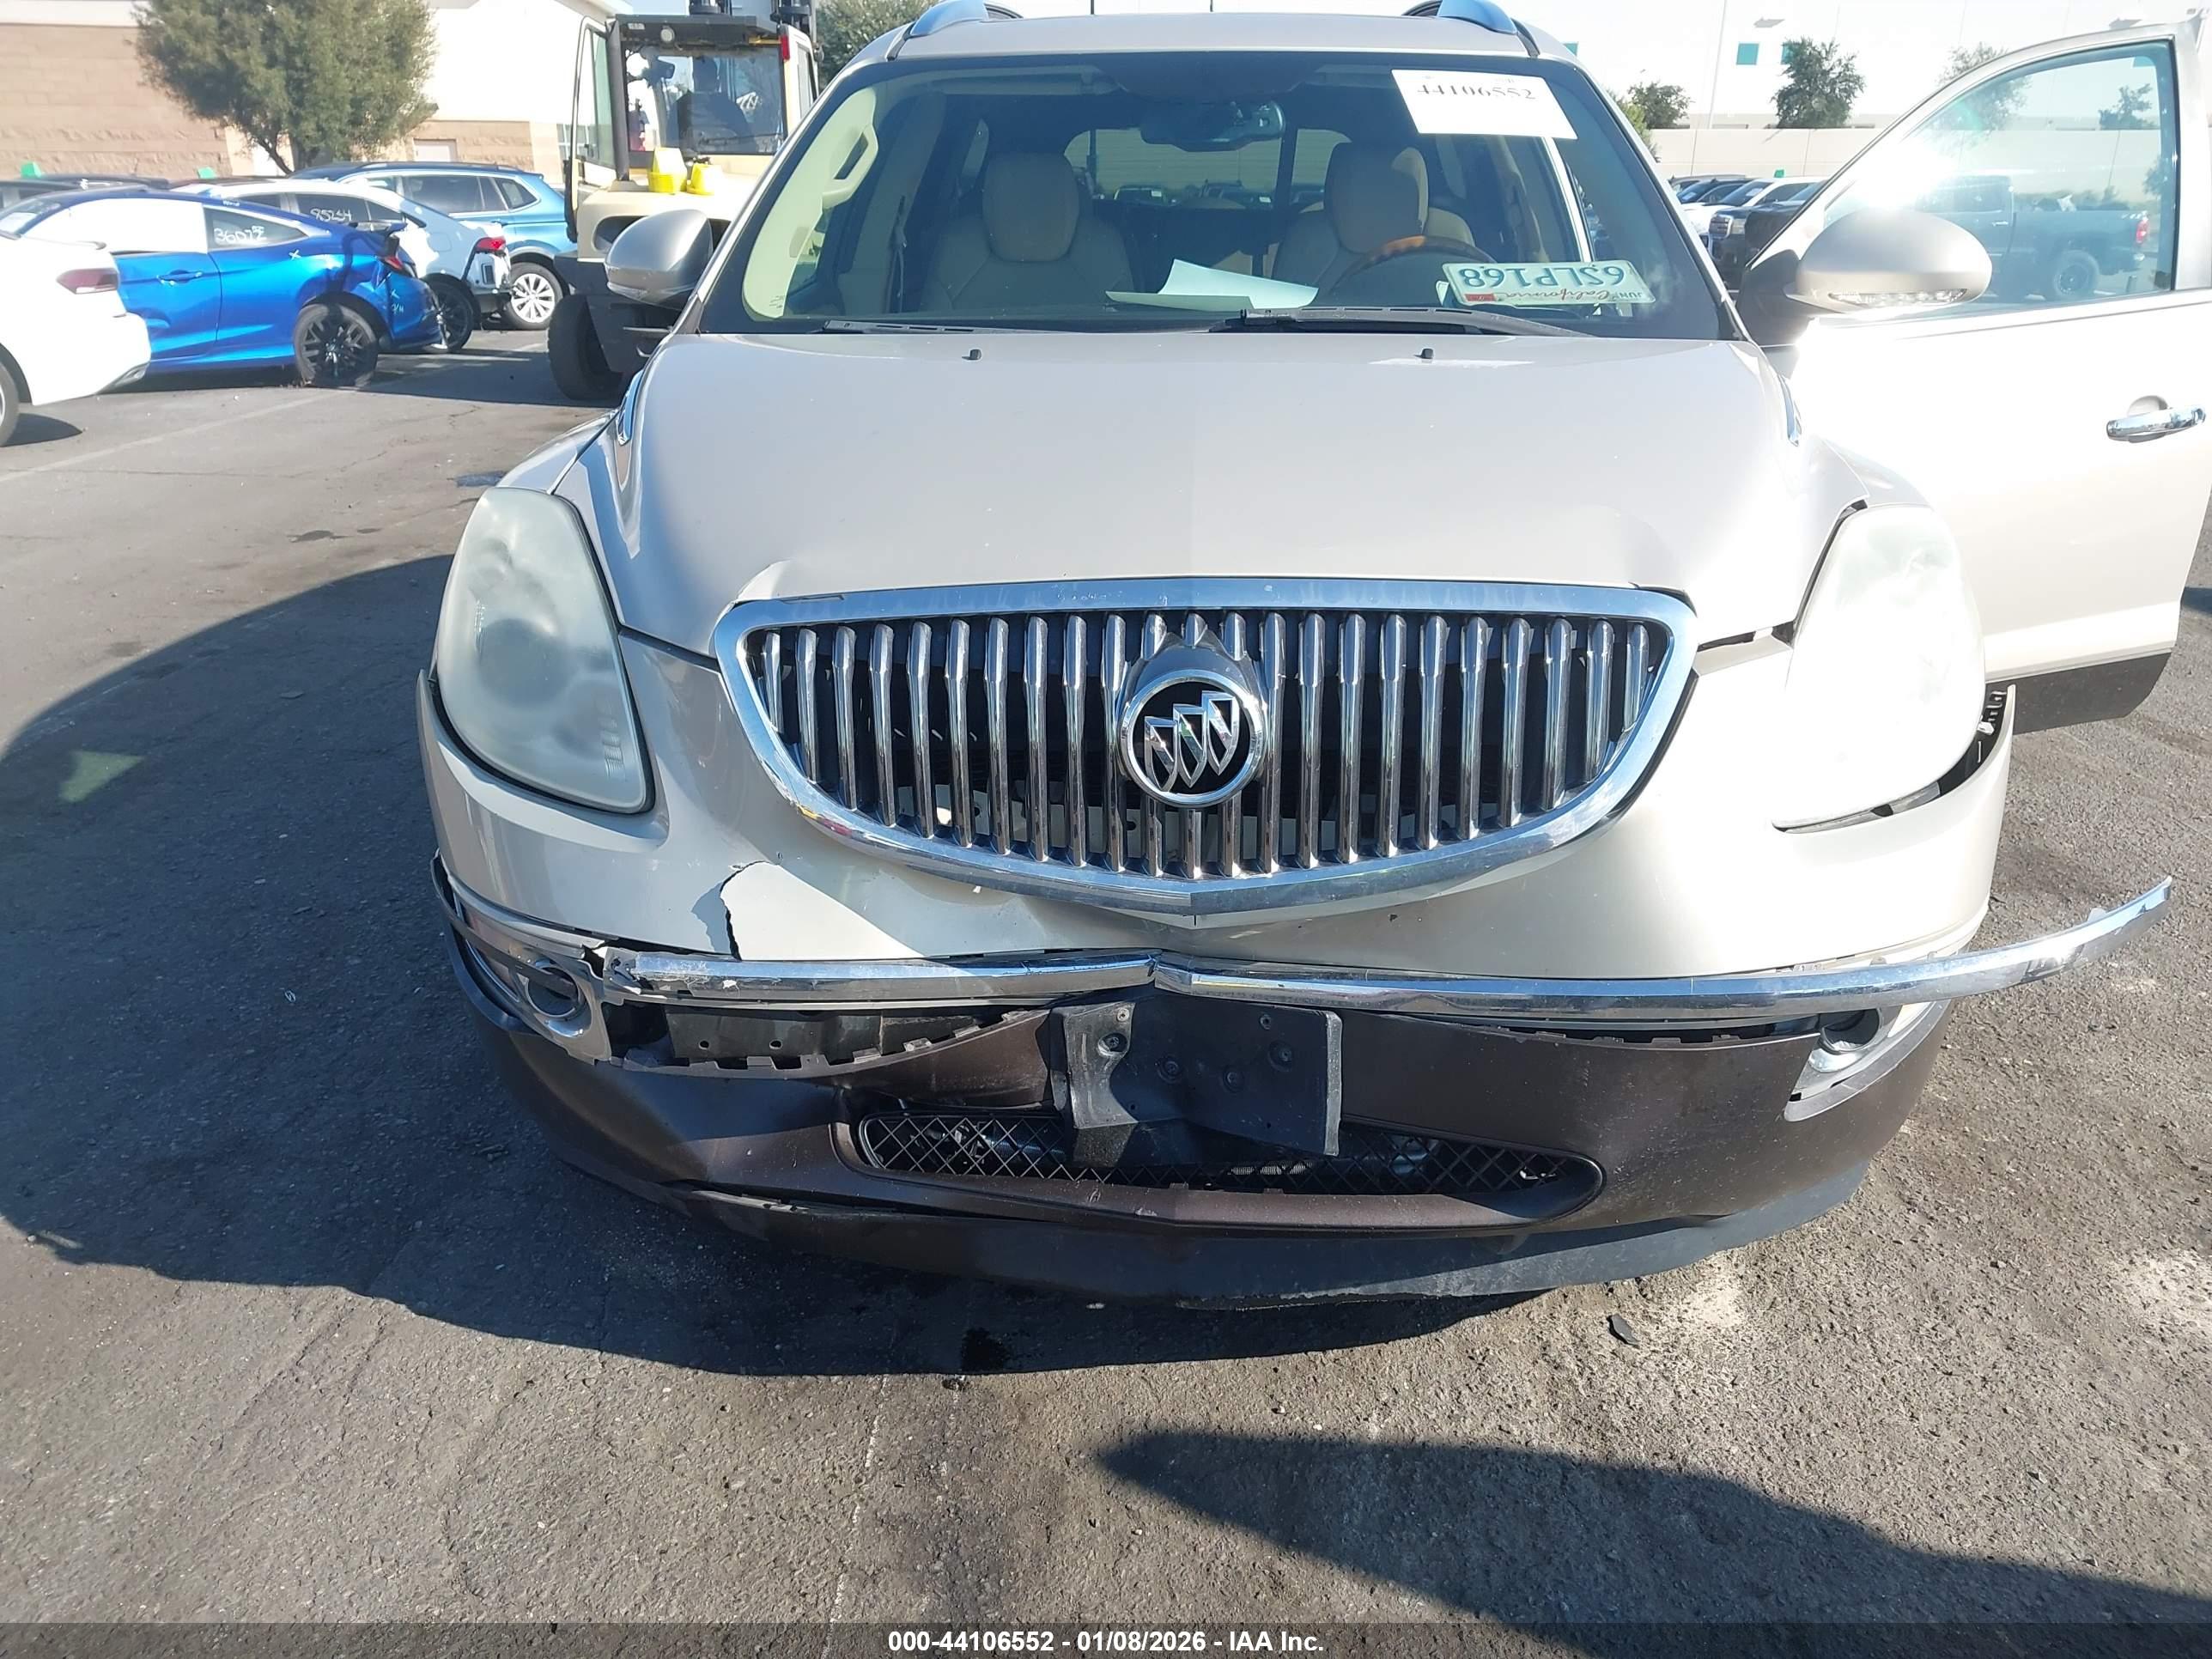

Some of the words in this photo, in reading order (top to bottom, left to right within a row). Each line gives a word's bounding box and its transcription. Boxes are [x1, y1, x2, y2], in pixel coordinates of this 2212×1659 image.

[1416, 83, 1536, 100] 44106552
[1458, 265, 1626, 289] 6SLP168
[1498, 288, 1611, 301] California
